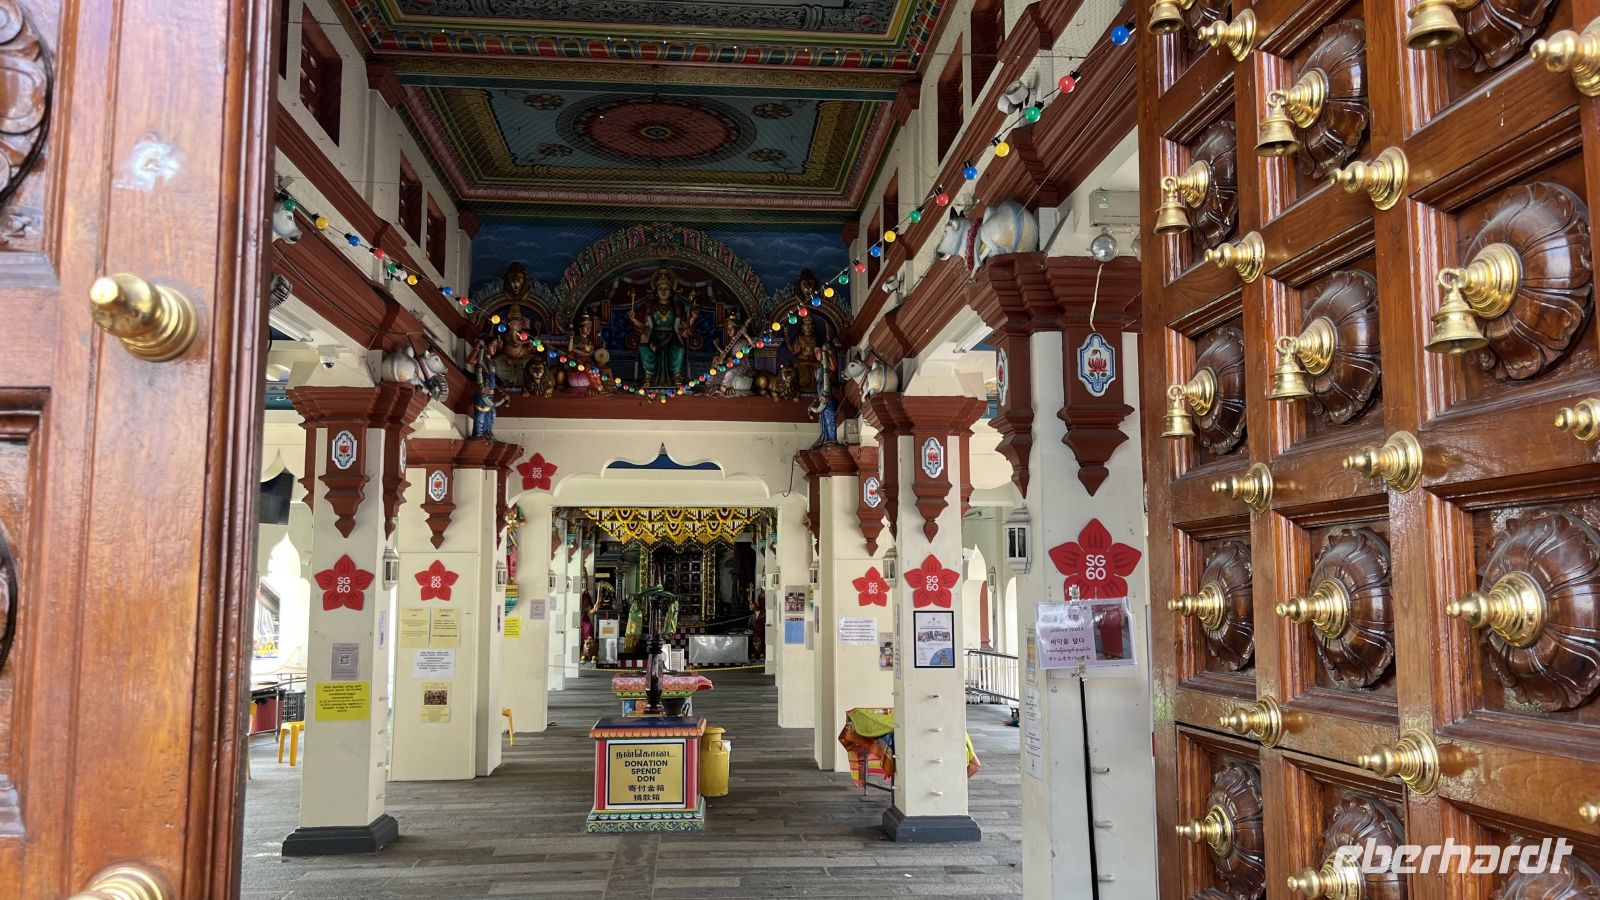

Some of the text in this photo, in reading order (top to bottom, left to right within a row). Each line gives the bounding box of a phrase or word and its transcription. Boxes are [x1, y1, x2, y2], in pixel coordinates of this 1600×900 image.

[1086, 554, 1106, 567] SG
[1086, 567, 1106, 580] 60
[337, 576, 350, 585] SG
[926, 575, 939, 584] SG
[337, 584, 350, 593] 60
[926, 583, 939, 592] 60
